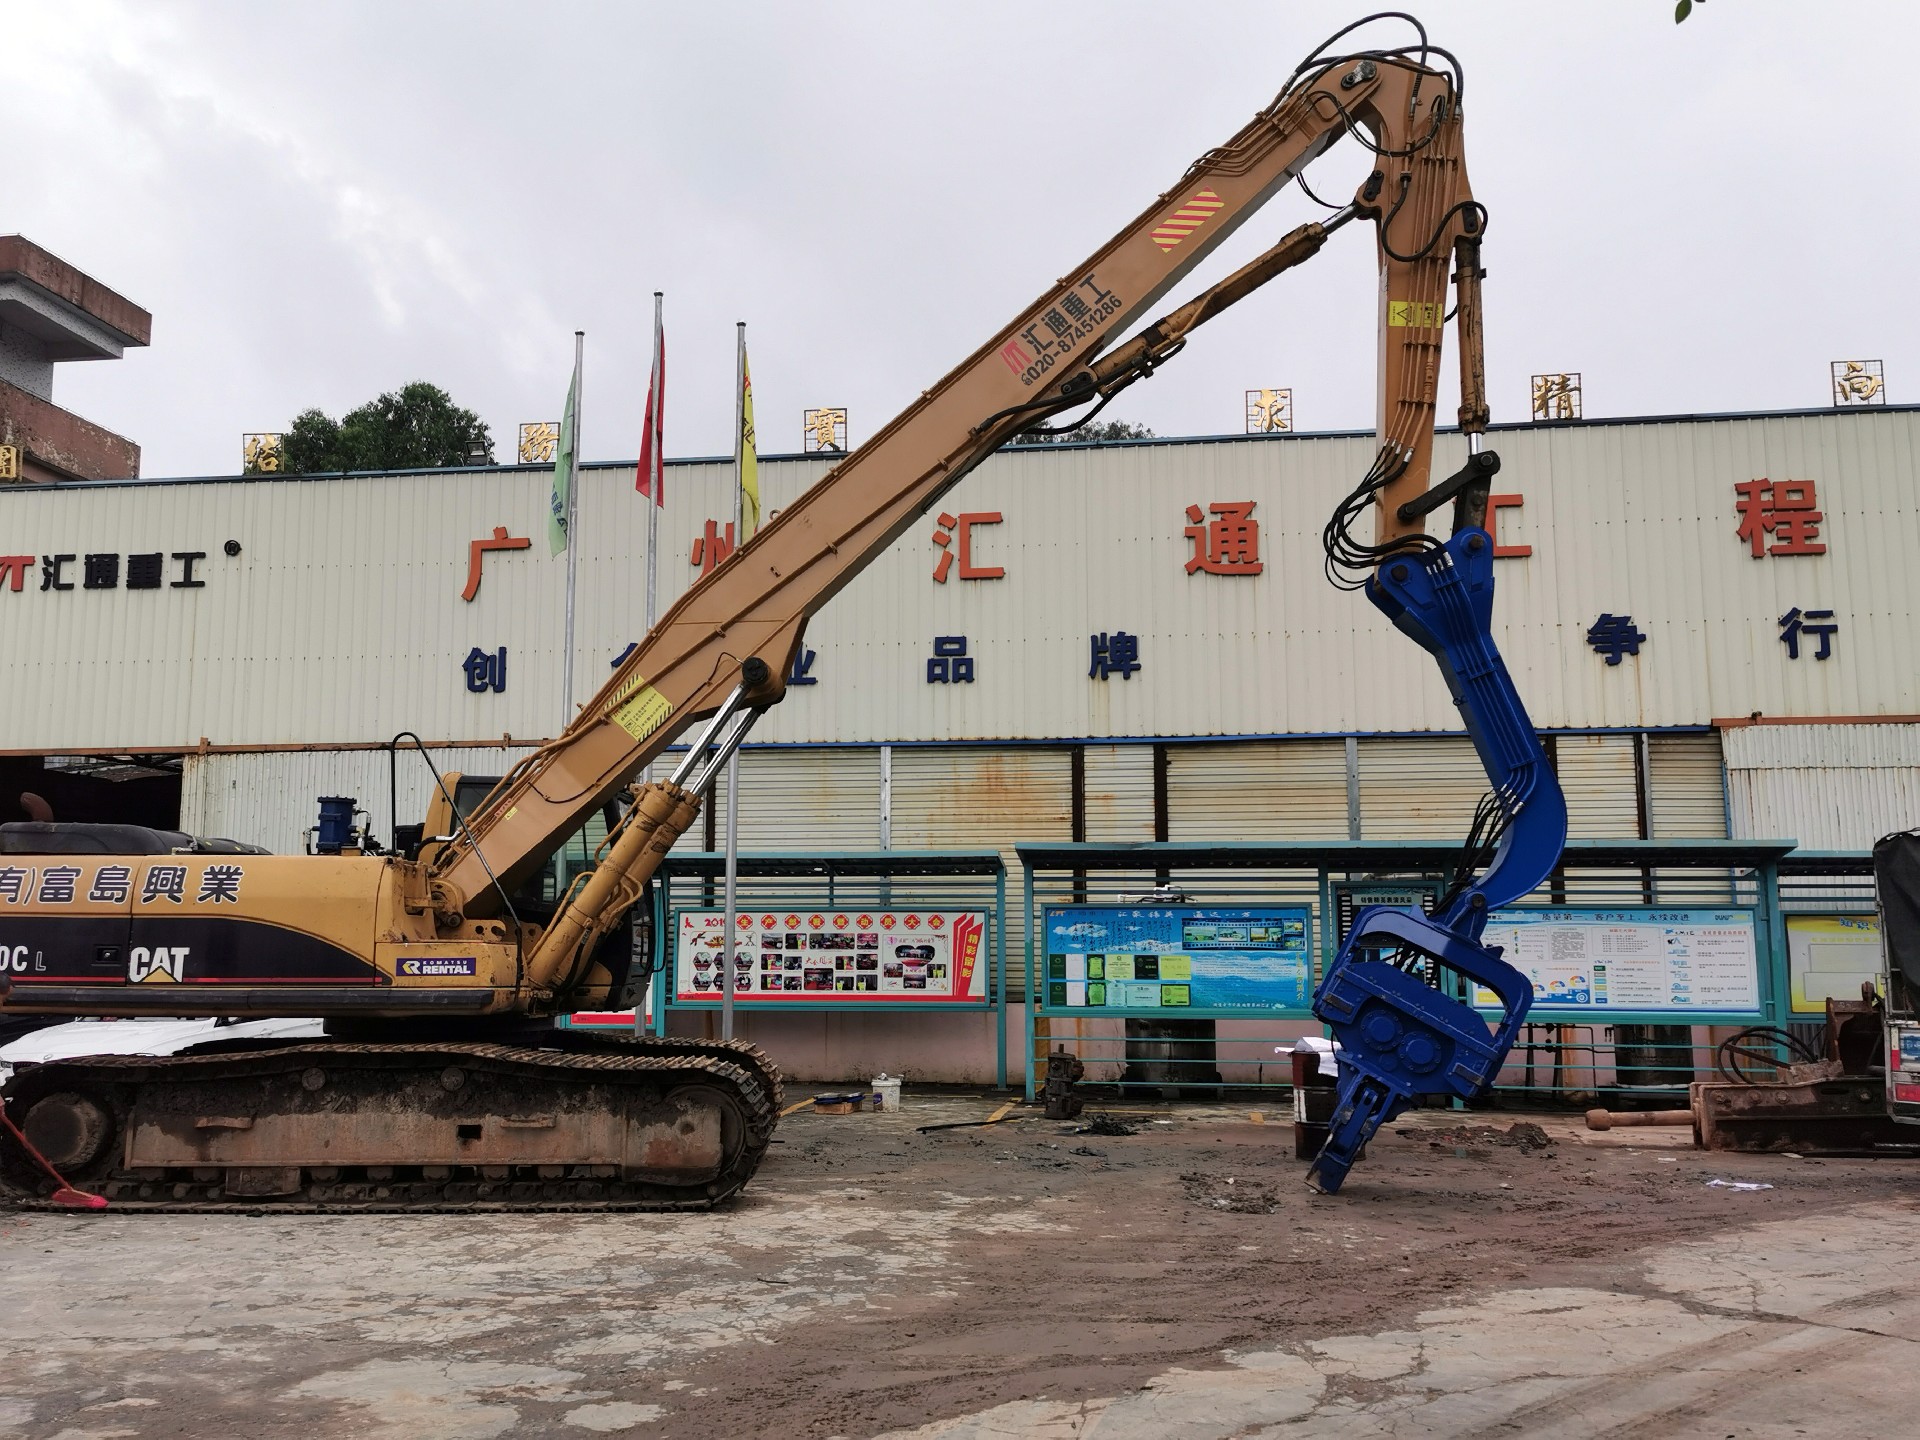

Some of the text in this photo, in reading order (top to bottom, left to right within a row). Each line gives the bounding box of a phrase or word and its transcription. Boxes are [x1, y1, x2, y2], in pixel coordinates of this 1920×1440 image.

[1020, 273, 1112, 355] 汇通重工
[1026, 294, 1123, 382] 020-87451286
[40, 551, 207, 592] 汇通重工
[704, 917, 726, 927] 201
[35, 950, 47, 971] L
[129, 946, 190, 983] CAT
[422, 965, 471, 975] RENTAL
